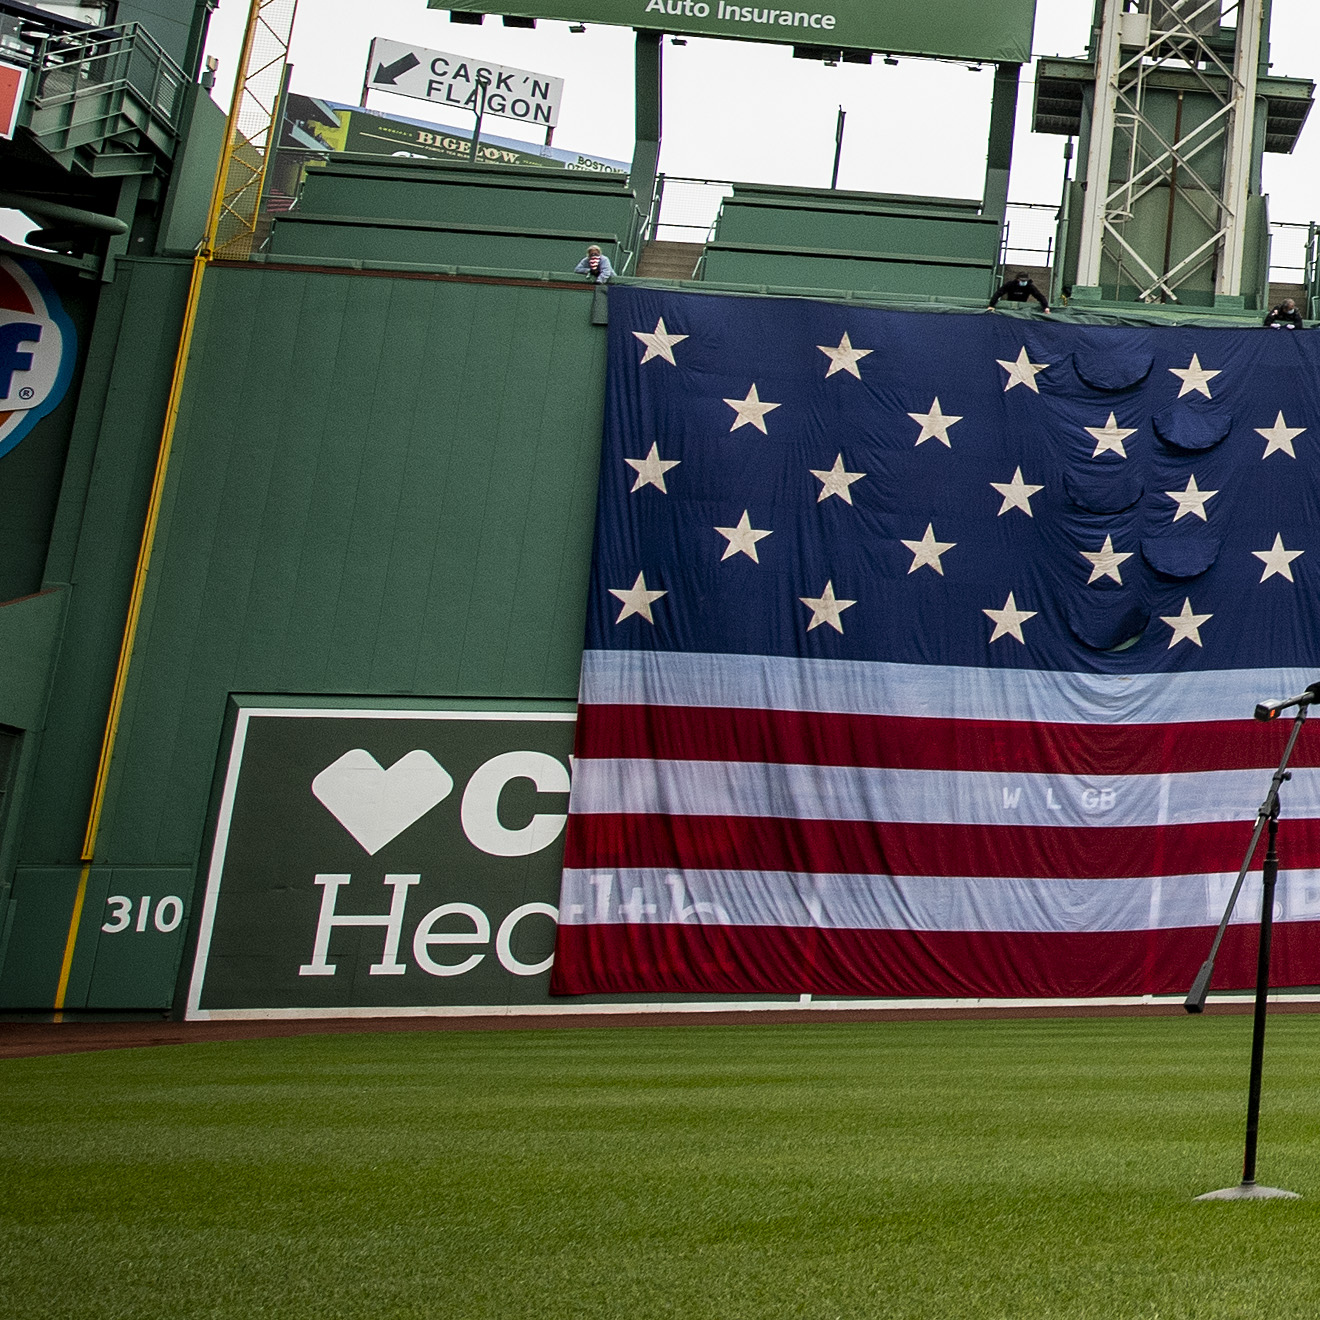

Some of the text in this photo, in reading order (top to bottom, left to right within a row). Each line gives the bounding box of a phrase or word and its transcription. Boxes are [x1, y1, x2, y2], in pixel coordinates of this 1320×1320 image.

[716, 0, 837, 31] Insurance
[430, 57, 516, 93] CASK
[416, 130, 520, 164] BIGELOW
[101, 895, 185, 934] 310
